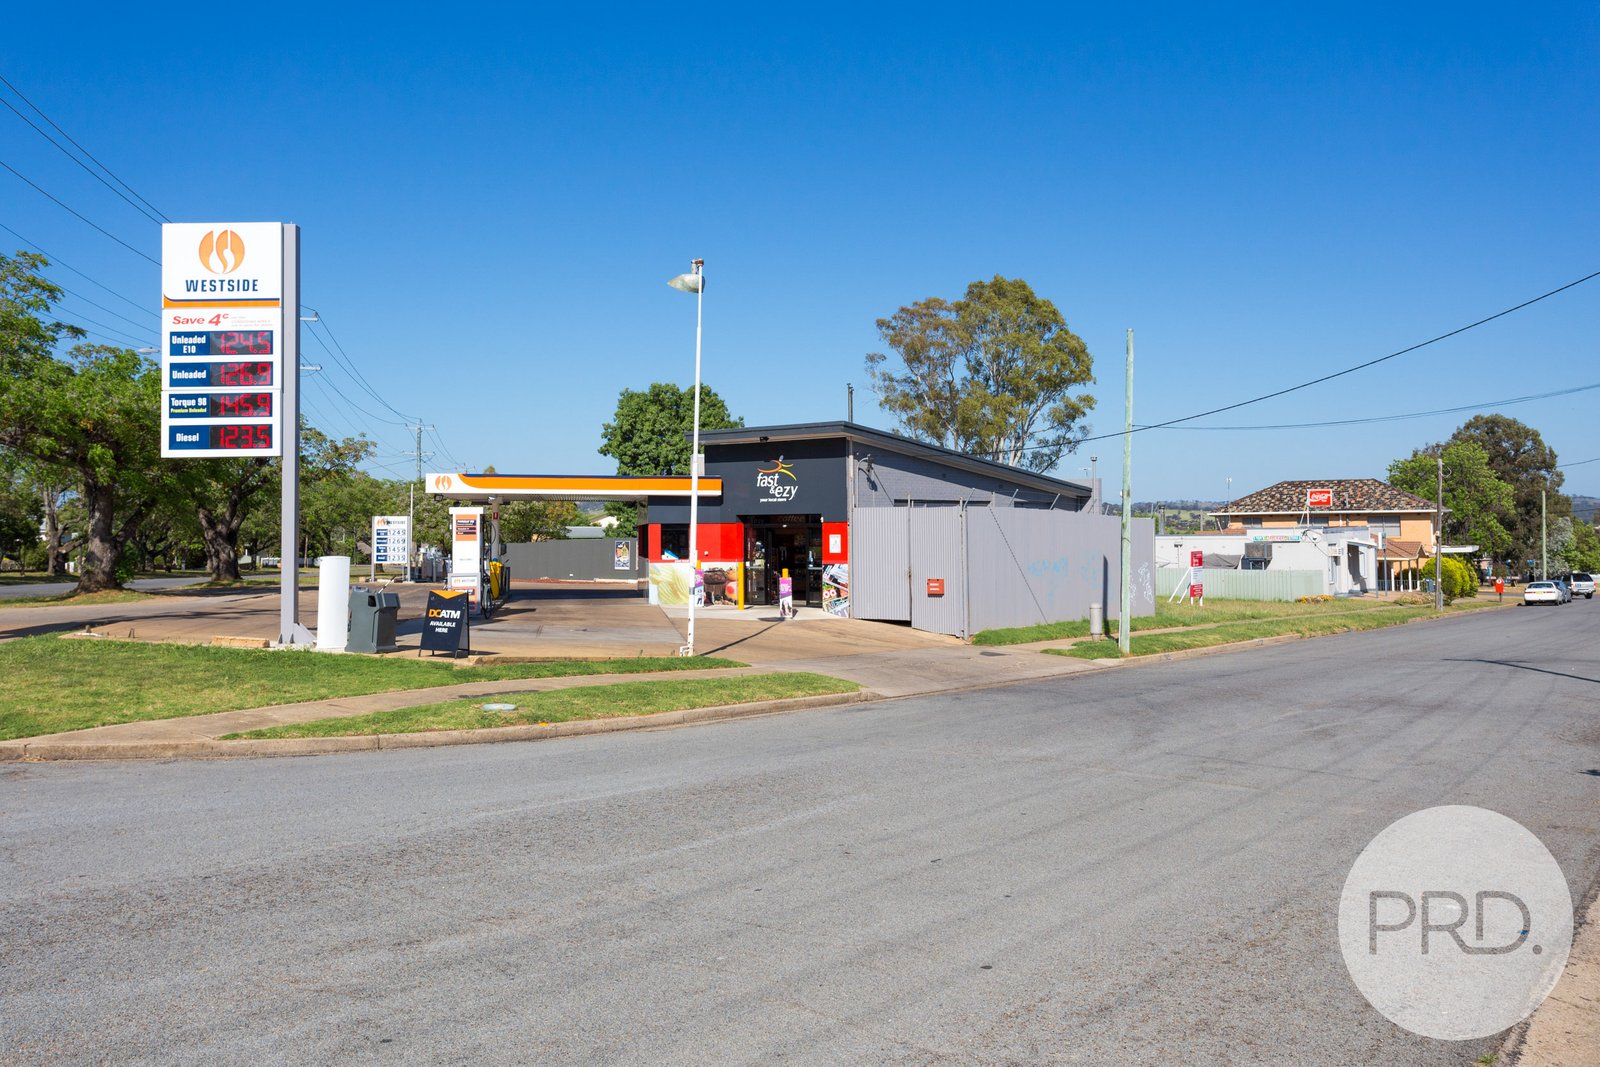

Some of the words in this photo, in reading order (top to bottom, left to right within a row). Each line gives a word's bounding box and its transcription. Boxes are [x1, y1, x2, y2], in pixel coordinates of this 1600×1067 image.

[185, 279, 259, 292] WESTSIDE
[172, 315, 205, 325] Save
[171, 335, 206, 344] Unleaded
[183, 345, 197, 353] E10
[172, 370, 207, 379] Unleaded
[170, 397, 196, 408] Torque
[198, 397, 207, 406] 98
[176, 433, 199, 442] Diesel
[756, 472, 779, 487] fast
[775, 485, 798, 501] ezy
[429, 620, 456, 628] AVAILABLE
